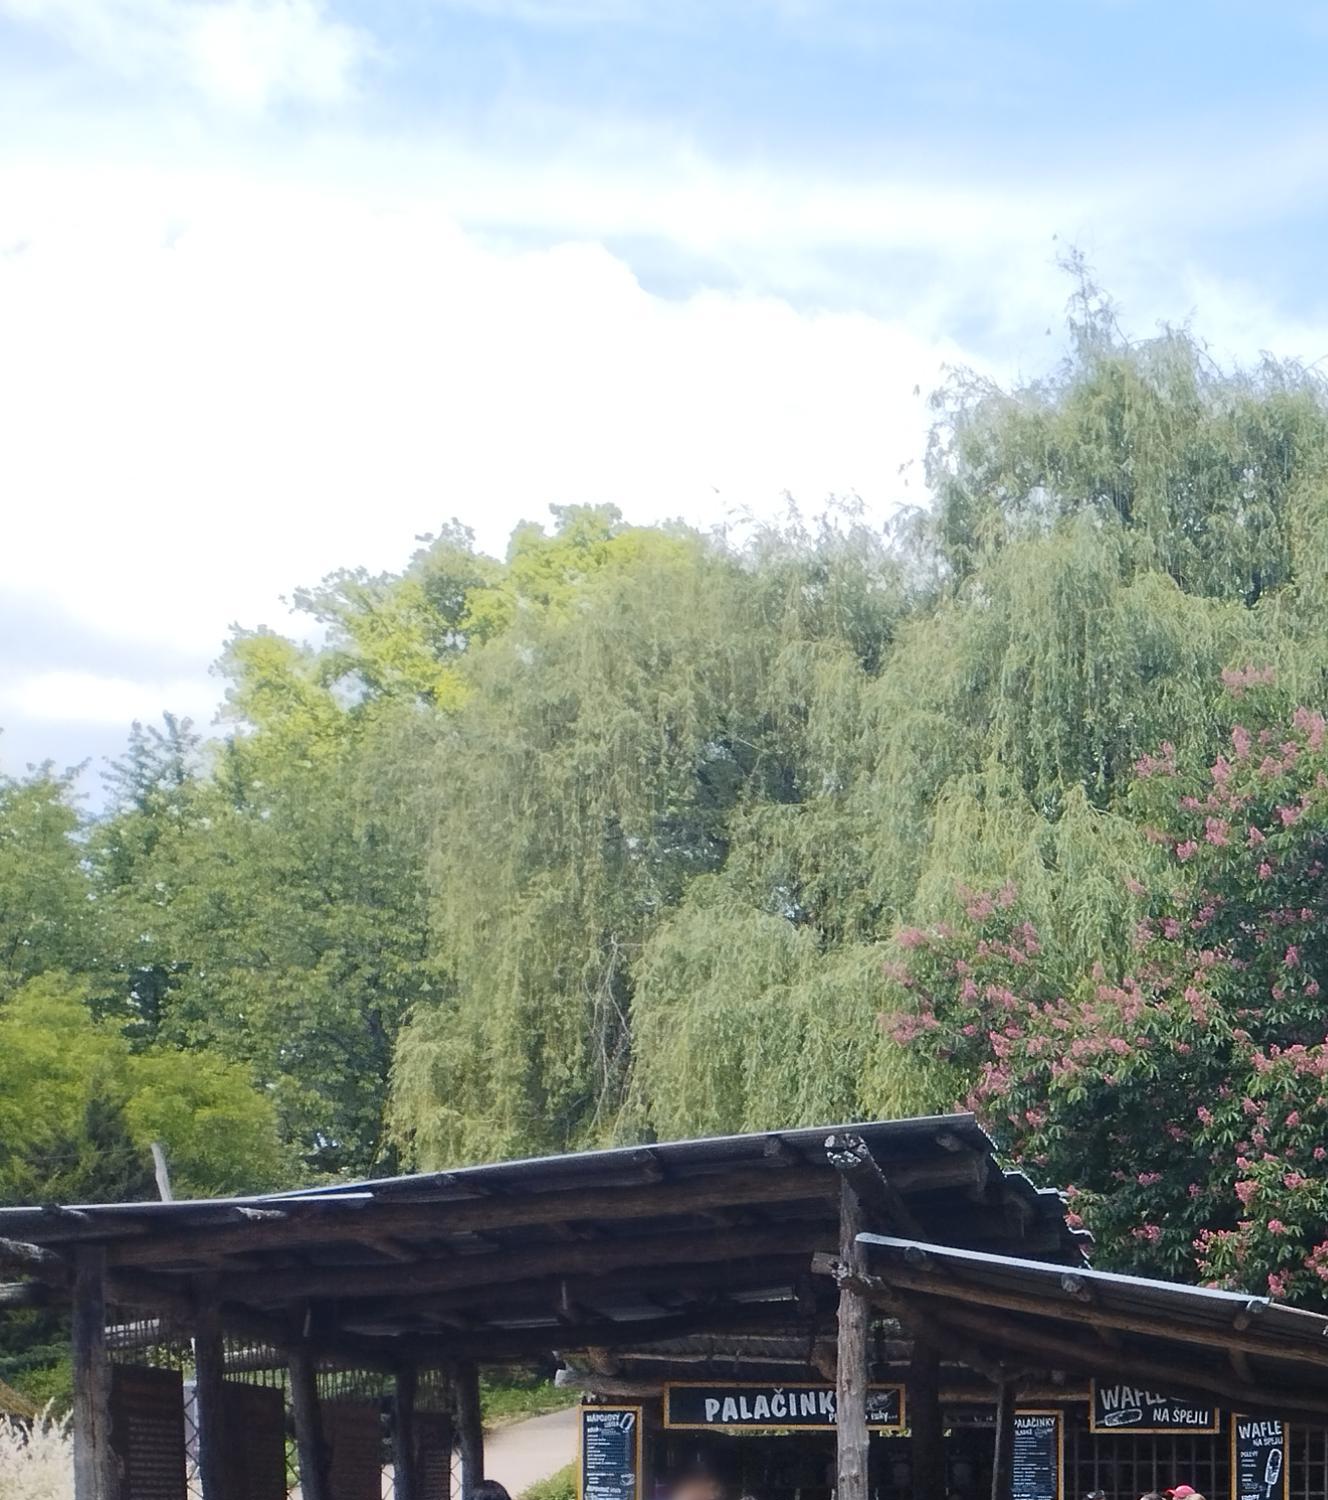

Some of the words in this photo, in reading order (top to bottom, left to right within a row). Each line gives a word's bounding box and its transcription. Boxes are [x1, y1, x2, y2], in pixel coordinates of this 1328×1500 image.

[705, 1387, 838, 1422] PALAČINK
[1153, 1408, 1169, 1423] NA
[1172, 1406, 1208, 1425] ŠPEJLI
[1238, 1420, 1282, 1439] WAFLE
